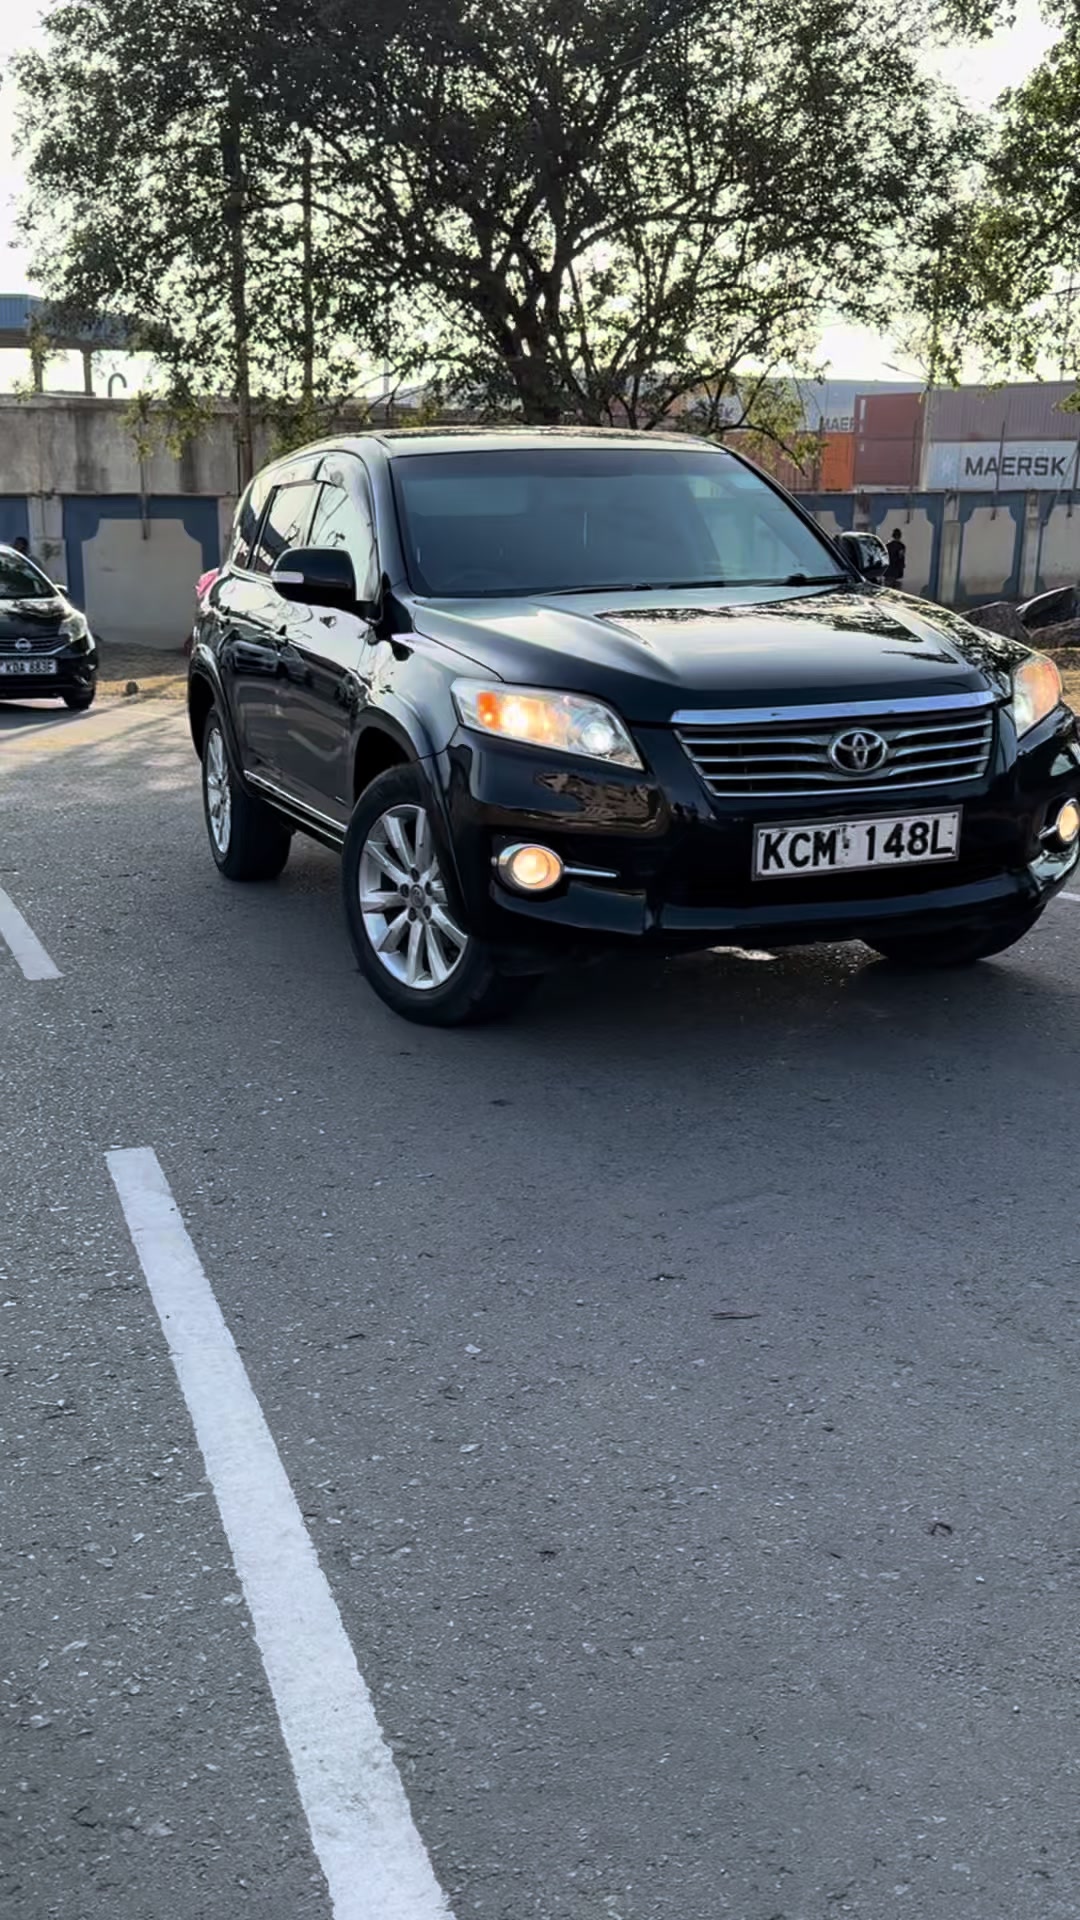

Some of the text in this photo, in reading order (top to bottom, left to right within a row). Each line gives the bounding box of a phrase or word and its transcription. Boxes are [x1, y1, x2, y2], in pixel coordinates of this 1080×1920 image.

[965, 456, 1066, 476] MAERSK
[762, 819, 953, 870] KCM 148L
